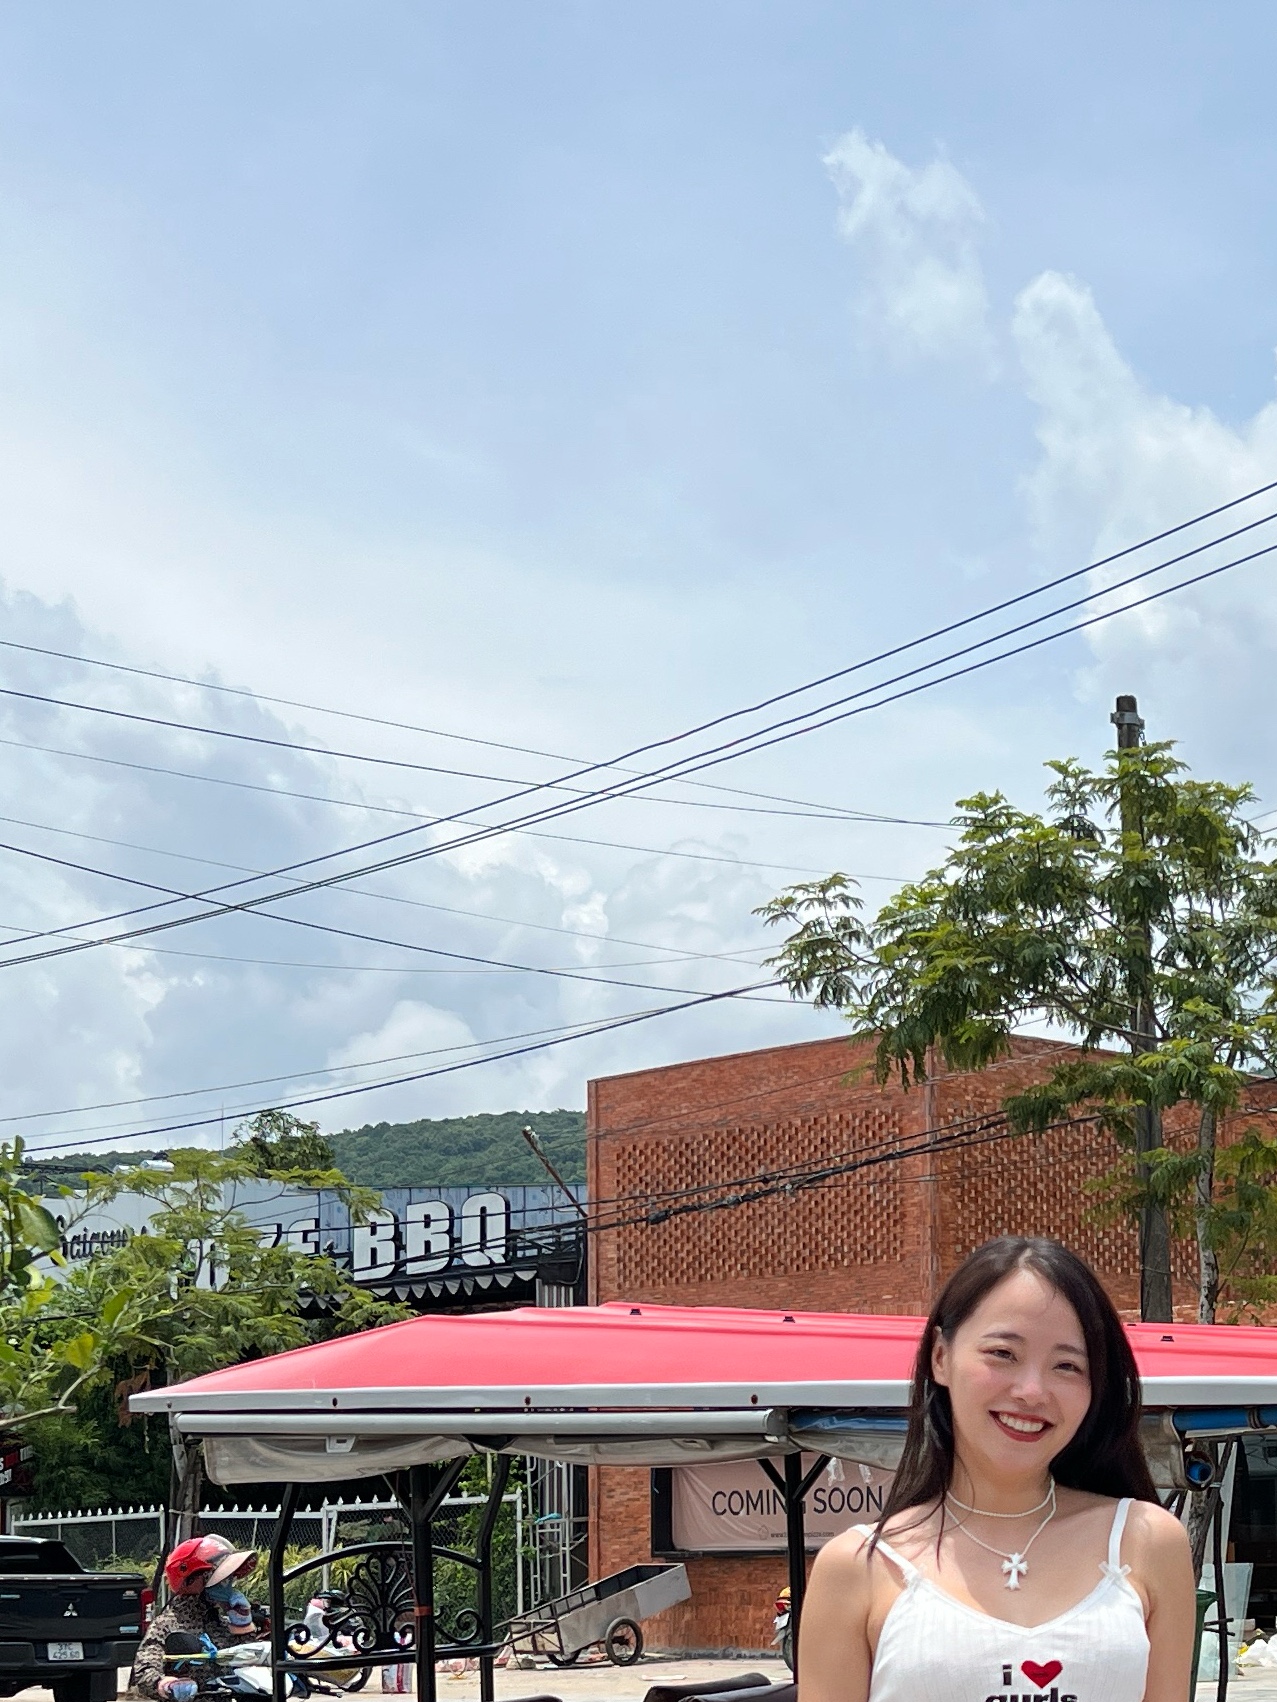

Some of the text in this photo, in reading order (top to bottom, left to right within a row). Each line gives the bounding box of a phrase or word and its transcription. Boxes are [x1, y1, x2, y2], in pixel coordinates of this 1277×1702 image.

[353, 1191, 511, 1282] BBQ
[712, 1485, 883, 1516] COMIN SOON
[1002, 1664, 1012, 1686] i
